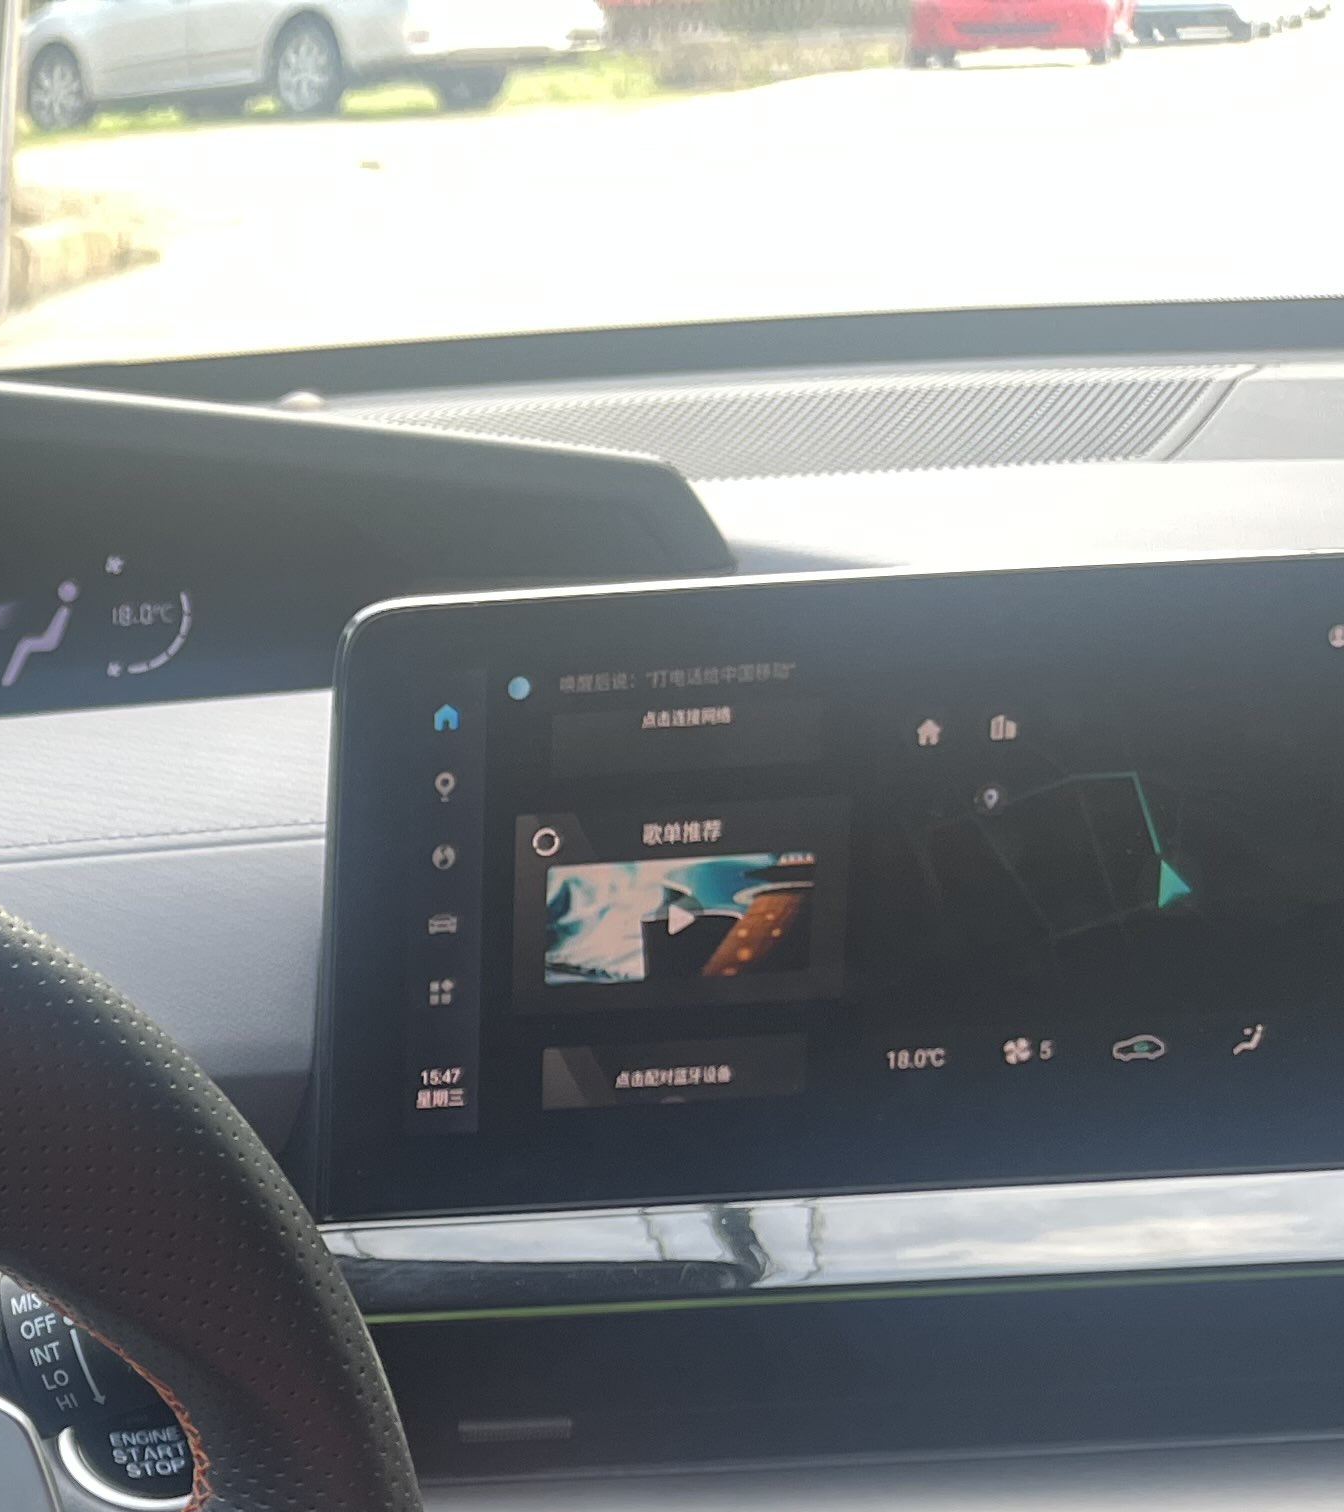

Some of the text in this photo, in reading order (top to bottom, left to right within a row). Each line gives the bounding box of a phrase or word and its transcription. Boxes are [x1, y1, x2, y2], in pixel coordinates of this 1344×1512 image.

[642, 819, 722, 846] 歌单推荐
[415, 1088, 465, 1110] 星期三
[10, 1291, 49, 1316] MIS
[20, 1313, 57, 1340] OFF
[29, 1341, 61, 1367] INT
[41, 1369, 69, 1391] LO
[55, 1393, 79, 1412] HI
[109, 1425, 182, 1447] ENGINE
[112, 1440, 186, 1464] START
[126, 1456, 185, 1478] STOP
